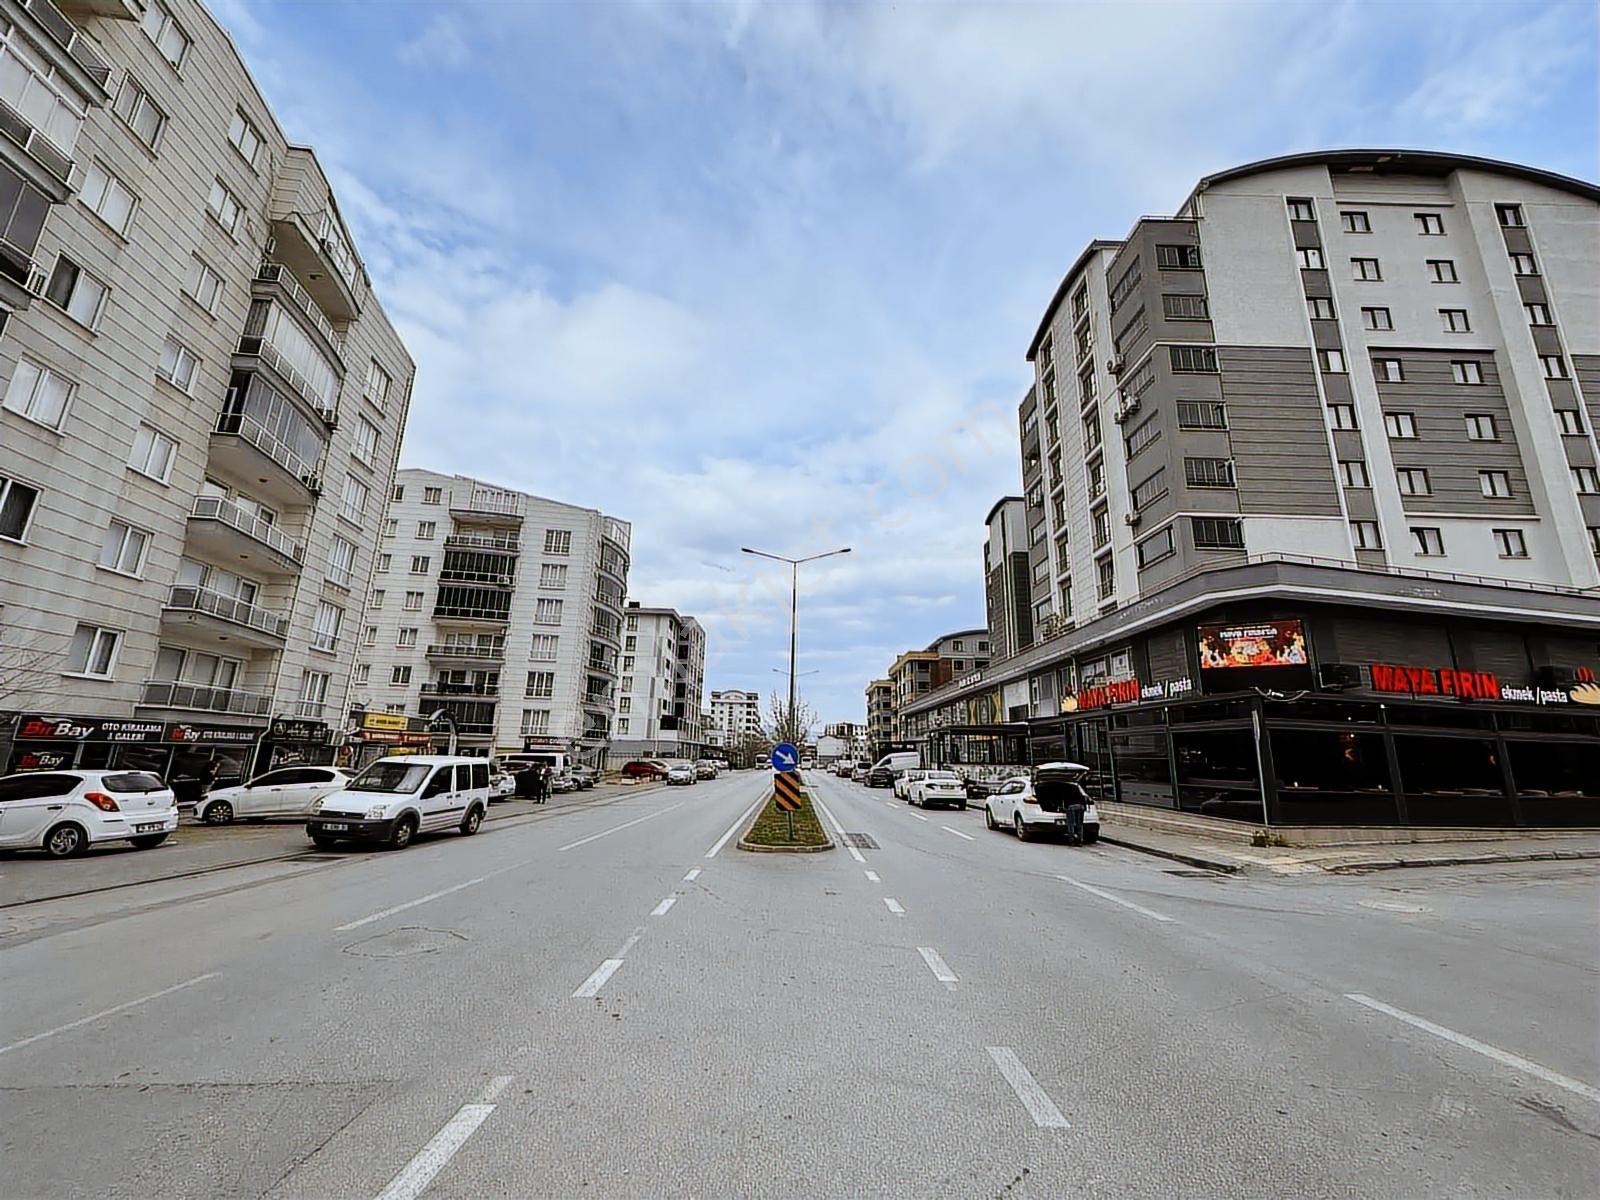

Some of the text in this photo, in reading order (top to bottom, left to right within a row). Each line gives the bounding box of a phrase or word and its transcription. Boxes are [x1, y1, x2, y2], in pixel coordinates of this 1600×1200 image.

[1371, 663, 1438, 695] MAYA
[1440, 669, 1501, 701] FIRIN
[1501, 685, 1535, 701] ekmek
[1078, 686, 1106, 710] MAYA
[1140, 683, 1164, 699] ekmek
[22, 719, 95, 740] BirBay
[101, 722, 120, 731] OTO
[20, 753, 64, 769] BirBay
